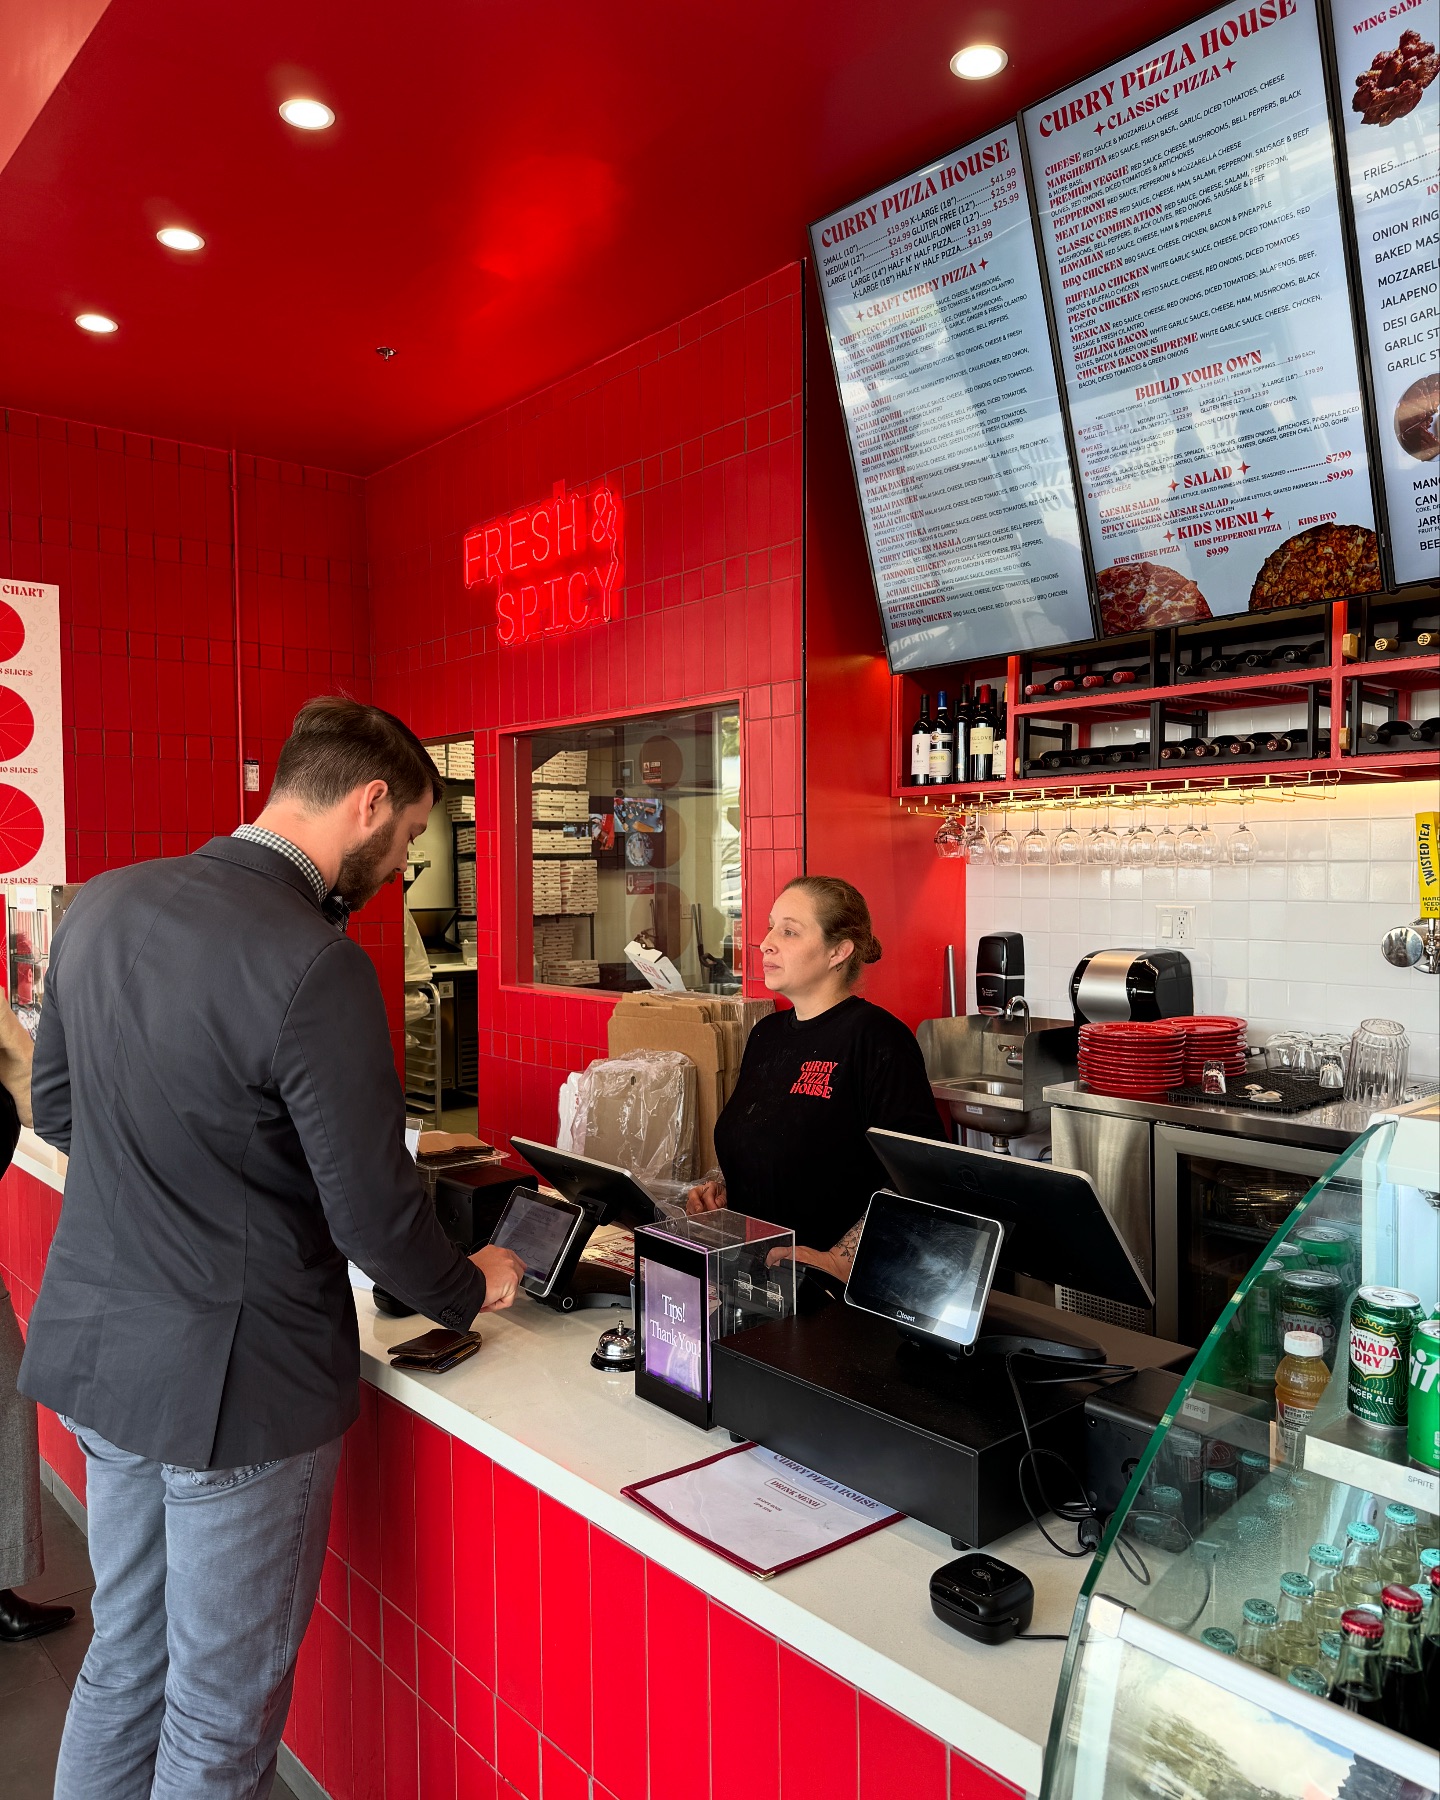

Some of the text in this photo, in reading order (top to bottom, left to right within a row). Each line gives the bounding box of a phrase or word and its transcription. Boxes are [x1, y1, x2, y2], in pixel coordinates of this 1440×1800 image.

[1353, 11, 1387, 35] WING
[1039, 0, 1297, 137] CURRY PIZZA HOUSE
[1106, 62, 1221, 131] CLASSIC PIZZA
[1044, 107, 1178, 177] CHEESE RED SAUCE & MOZZARELLA CHEESE
[1046, 154, 1106, 190] MARGHERITA
[1049, 164, 1129, 209] PREMIUM VEGGIE
[1052, 198, 1105, 229] PEPPERONI
[1106, 194, 1118, 205] RED
[1139, 171, 1170, 191] PEPPERONI
[1171, 168, 1176, 176] &
[1177, 150, 1216, 174] MOZZARELLA
[1217, 140, 1241, 156] CHEESE
[1363, 161, 1394, 180] FRIES
[821, 138, 1010, 248] CURRY PIZZA HOUSE
[909, 204, 939, 225] X-LARGE
[990, 166, 1016, 187] $41.99
[1366, 174, 1420, 204] SAMOSAS
[911, 217, 938, 236] GLUTEN
[939, 208, 956, 223] FREE
[990, 179, 1016, 199] $25.99
[913, 219, 961, 248] CAULIFLOWER
[993, 191, 1019, 211] $25.99
[1055, 206, 1118, 242] MEAT LOVERS
[822, 250, 843, 266] SMALL
[886, 218, 909, 237] $19.99
[1056, 203, 1162, 256] CLASSIC COMBINATION
[1372, 209, 1440, 242] ONION RING
[824, 259, 849, 277] MEDIUM
[888, 230, 911, 248] $24.99
[826, 273, 846, 288] LARGE
[890, 241, 912, 259] $31.99
[850, 273, 870, 289] LARGE
[887, 257, 905, 272] HALF
[913, 245, 931, 260] HALF
[932, 236, 952, 252] PIZZA
[966, 217, 992, 237] $31.99
[852, 281, 879, 299] X-LARGE
[895, 265, 913, 280] HALF
[922, 253, 940, 268] HALF
[940, 244, 961, 260] PIZZA
[967, 229, 993, 248] $41.99
[1059, 250, 1103, 275] HAWAIIAN
[1375, 243, 1412, 264] BAKED
[865, 261, 977, 319] CRAFT CURRY PIZZA
[1062, 257, 1123, 291] BBQ CHICKEN
[1065, 264, 1149, 305] BUFFALO CHICKEN
[1067, 289, 1140, 324] PESTO CHICKEN
[1380, 283, 1437, 309] JALAPENO
[1070, 321, 1111, 343] MEXICAN
[1383, 316, 1407, 332] DESI
[1073, 328, 1148, 362] SIZZLING BACON
[1076, 332, 1198, 381] CHICKEN BACON SUPREME
[1384, 332, 1424, 352] GARLIC
[1135, 349, 1262, 401] BUILD YOUR OWN
[1387, 352, 1427, 372] GARLIC
[1098, 449, 1352, 518] CAESAR SALAD $7.99
[1182, 464, 1233, 489] SALAD
[1101, 467, 1353, 534] SPICY CHICKEN CAESAR SALAD $9.99
[1415, 493, 1438, 507] CAN
[1176, 510, 1258, 539] KIDS MENU
[1193, 522, 1281, 547] KIDS PEPPERONI PIZZA
[1298, 510, 1336, 525] KIDS BYO
[464, 493, 613, 585] FRESH &
[878, 536, 961, 564] CURRY CHICKEN MASALA
[1113, 544, 1180, 564] KIDS CHEESE PIZZA
[1205, 545, 1229, 558] $9.99
[2, 584, 45, 598] CHART
[497, 561, 615, 641] SPICY
[4, 667, 33, 677] SLICES
[1418, 823, 1438, 887] TWISTED TEA
[797, 1071, 831, 1086] PIZZA
[800, 1060, 839, 1074] CURRY
[789, 1082, 834, 1099] HOUSE
[661, 1293, 686, 1325] Tips!
[649, 1318, 702, 1358] Thank You!
[1350, 1335, 1401, 1359] ANADA
[1354, 1349, 1383, 1369] DRY
[1375, 1395, 1394, 1405] ALE
[770, 1480, 798, 1496] DRINK
[794, 1493, 821, 1508] MENU
[773, 1454, 879, 1509] CURRY PIZZA HOUSE
[1407, 1475, 1435, 1490] SPRITE
